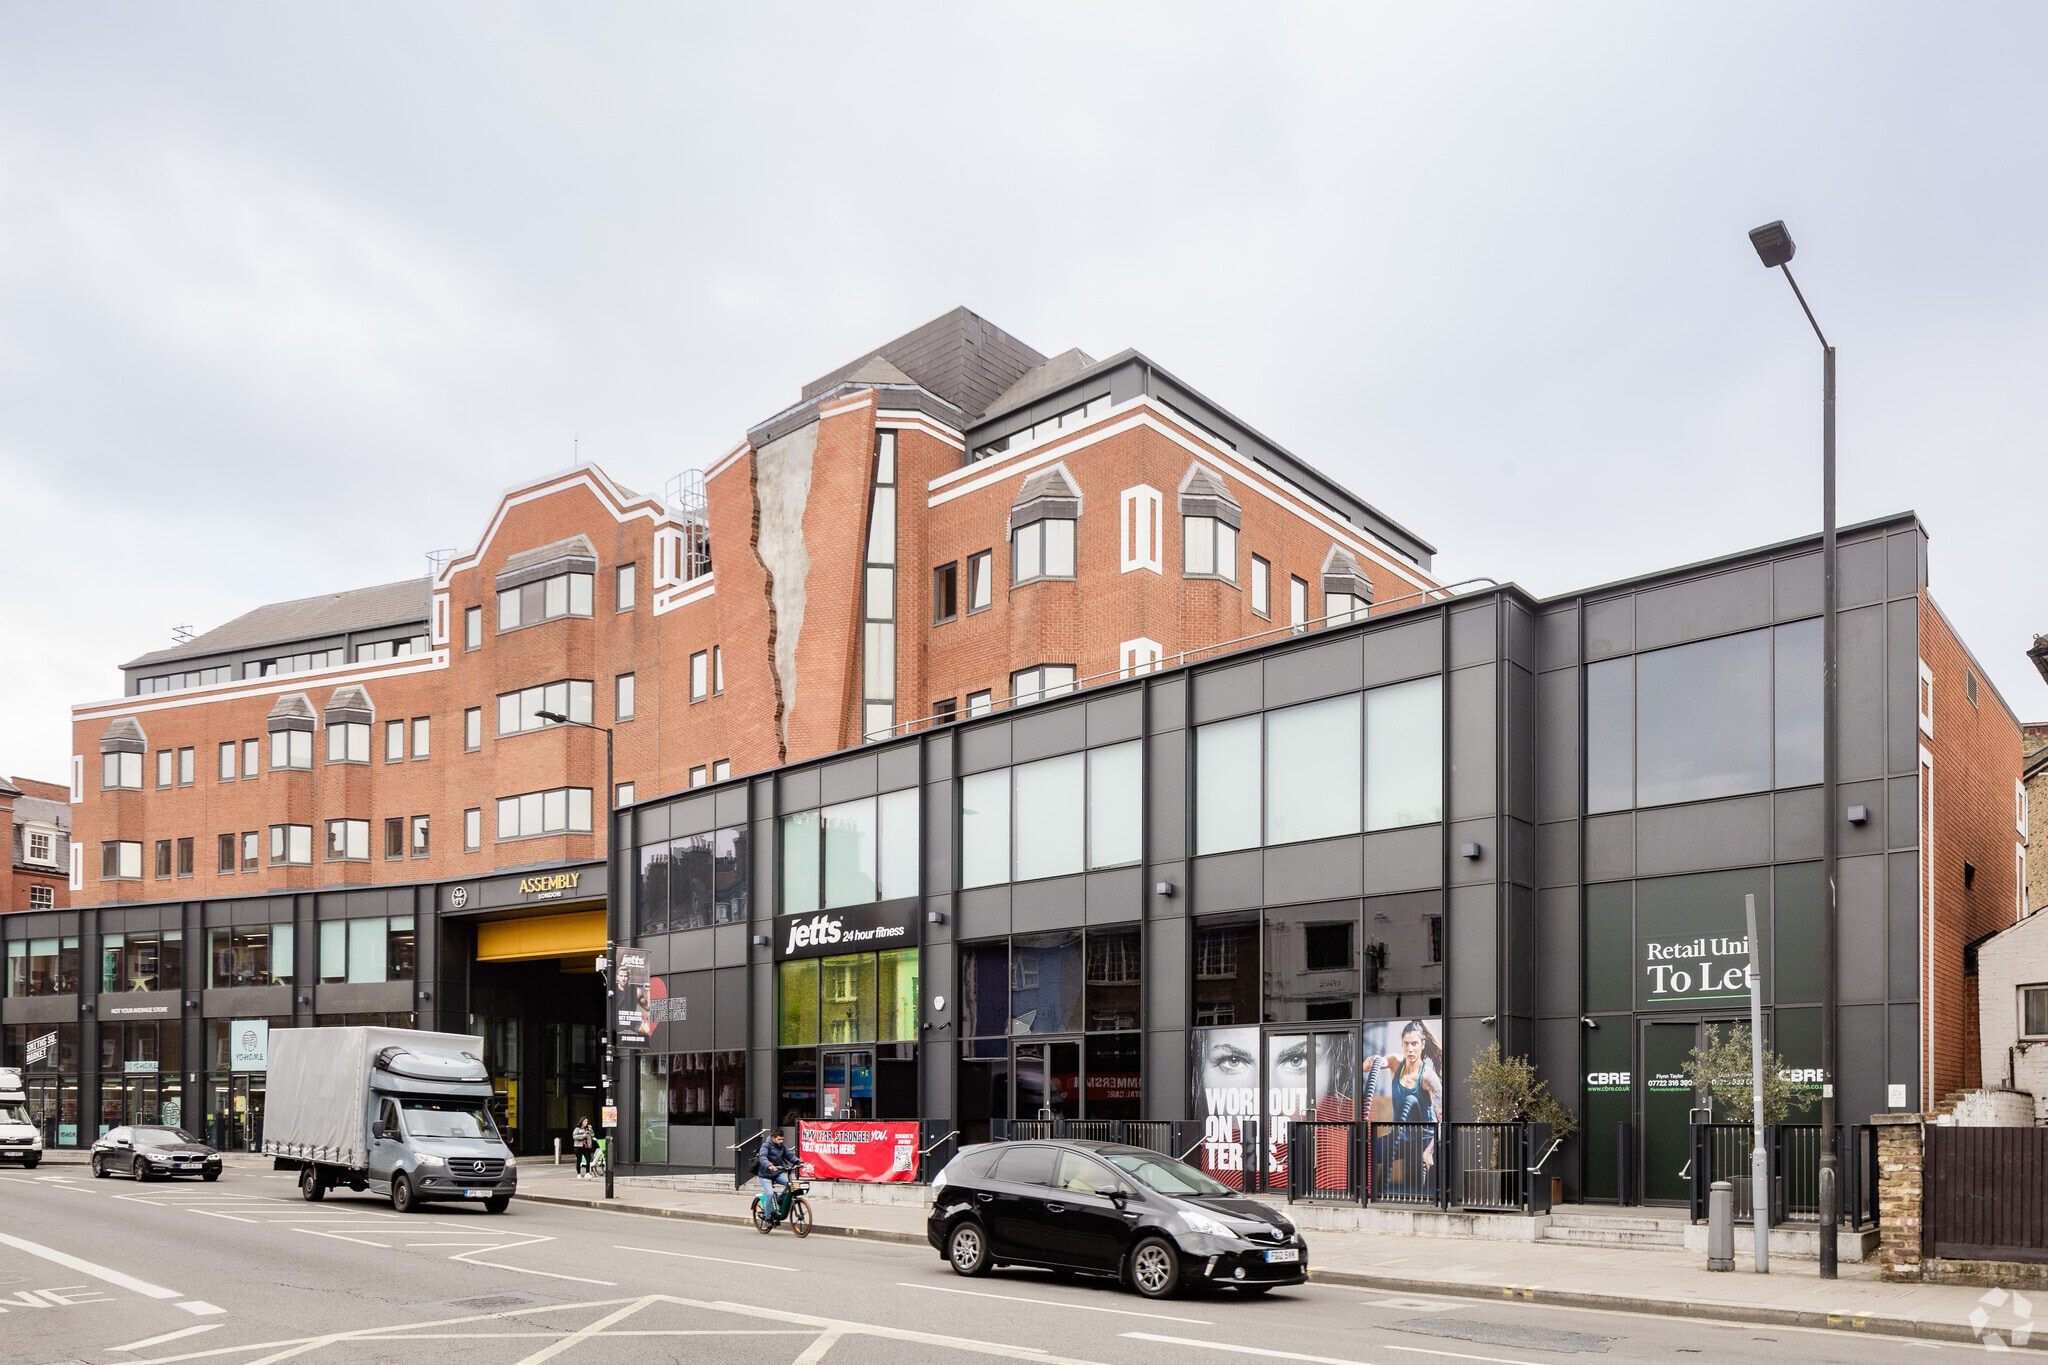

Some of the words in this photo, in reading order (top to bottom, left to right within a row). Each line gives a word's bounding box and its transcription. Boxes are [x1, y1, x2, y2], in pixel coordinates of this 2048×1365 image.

[519, 872, 579, 894] ASSEMBLY
[538, 891, 562, 900] LONDON
[786, 914, 842, 955] jetts
[842, 930, 854, 943] 24
[854, 929, 875, 942] hour
[875, 925, 905, 938] fitness
[1647, 938, 1706, 960] Retail
[1709, 935, 1750, 956] Uni
[621, 954, 645, 965] jetts
[1647, 964, 1691, 993] To
[1699, 962, 1752, 991] Let
[26, 1036, 47, 1052] SMITHS
[26, 1047, 47, 1063] MARKET
[236, 1053, 264, 1061] YOHOME
[1587, 1072, 1631, 1085] CBRE
[1648, 1079, 1668, 1087] 07722
[1205, 1115, 1233, 1143] ON
[834, 1130, 871, 1143] STRONGER
[814, 1143, 839, 1155] STARTS
[839, 1144, 856, 1155] HERE
